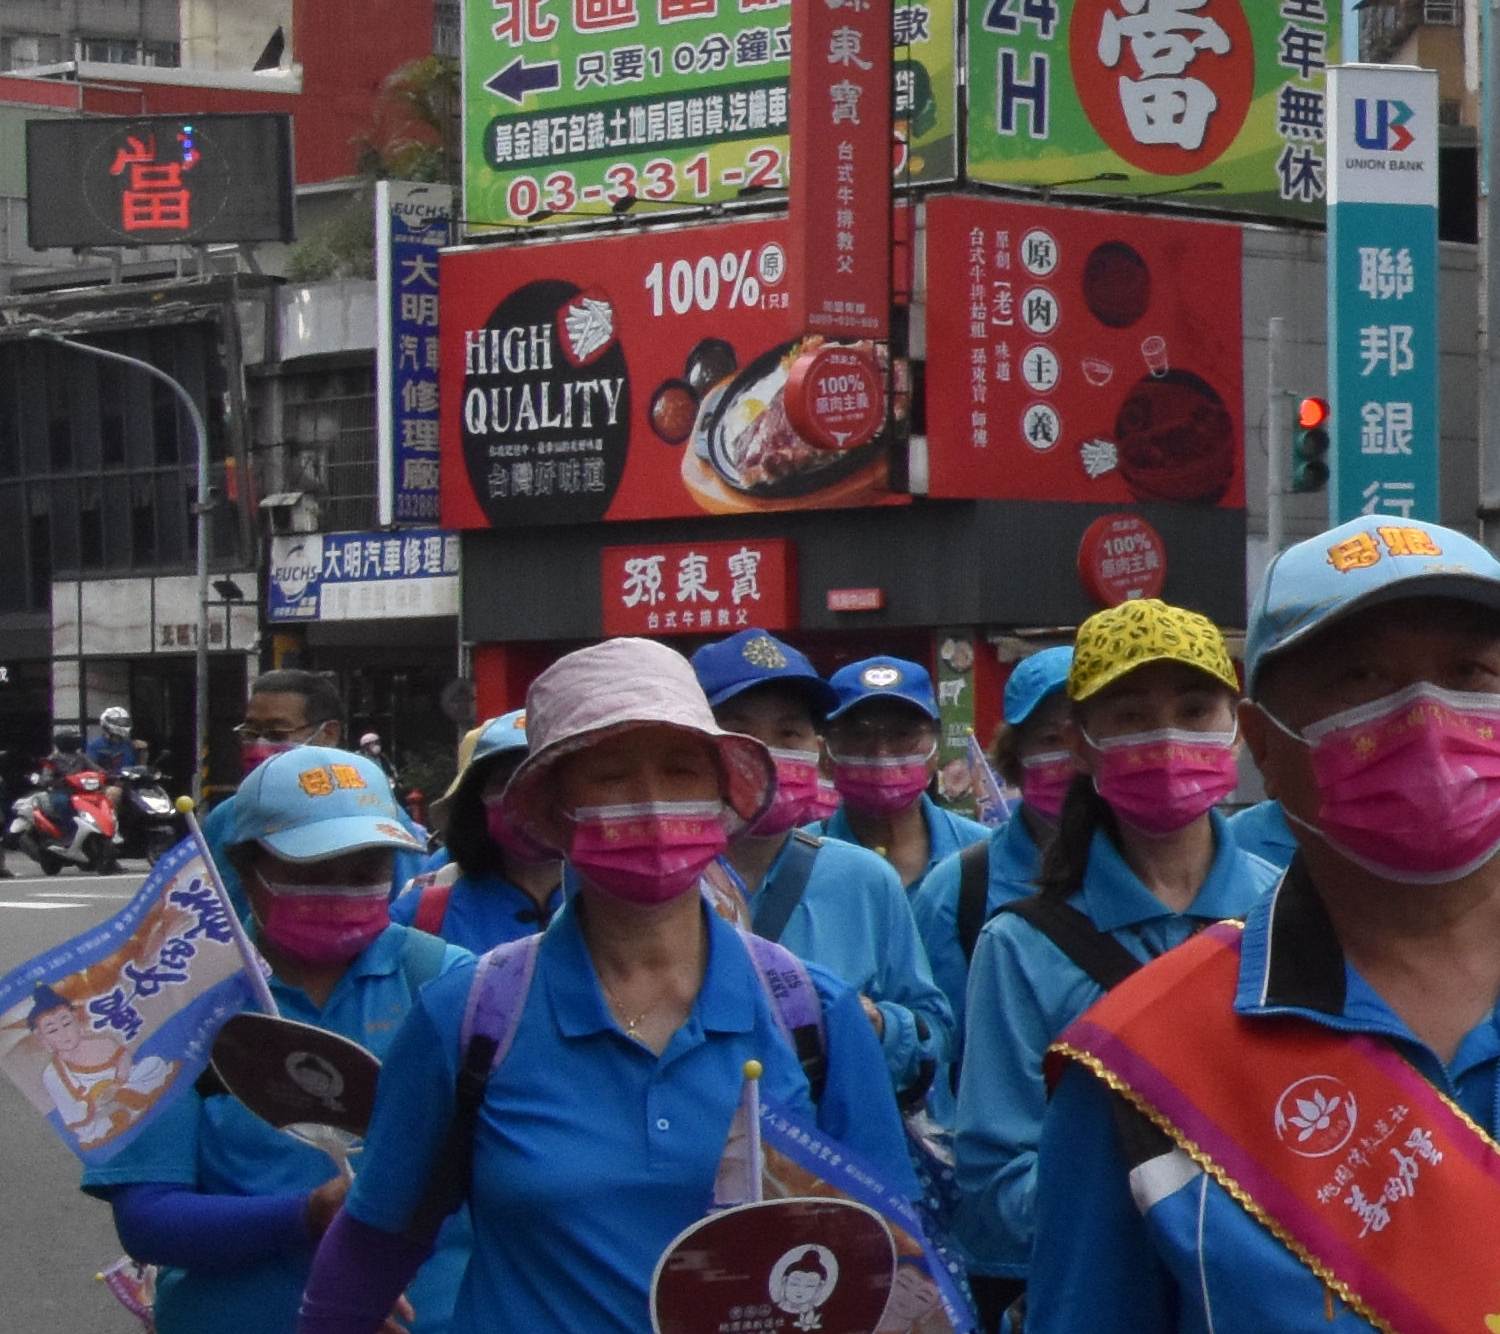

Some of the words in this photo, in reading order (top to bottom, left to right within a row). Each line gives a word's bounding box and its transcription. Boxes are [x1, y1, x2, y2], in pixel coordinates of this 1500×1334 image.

[1000, 49, 1049, 139] H
[508, 148, 789, 220] 03-331-2
[1345, 158, 1386, 172] UNION
[1389, 159, 1425, 173] BANK
[393, 202, 449, 220] FUCHS
[836, 141, 855, 276] 台式牛排教父
[645, 249, 760, 317] 100%
[464, 323, 554, 375] HIGH
[1023, 232, 1057, 446] 原肉主義
[464, 378, 624, 435] QUALITY
[817, 373, 866, 395] 100%
[1358, 246, 1416, 519] 聯邦銀行
[275, 565, 318, 582] FUCHS
[1102, 534, 1152, 557] 100%
[621, 546, 763, 609] 孫東寶
[647, 610, 749, 631] 台式牛排教父
